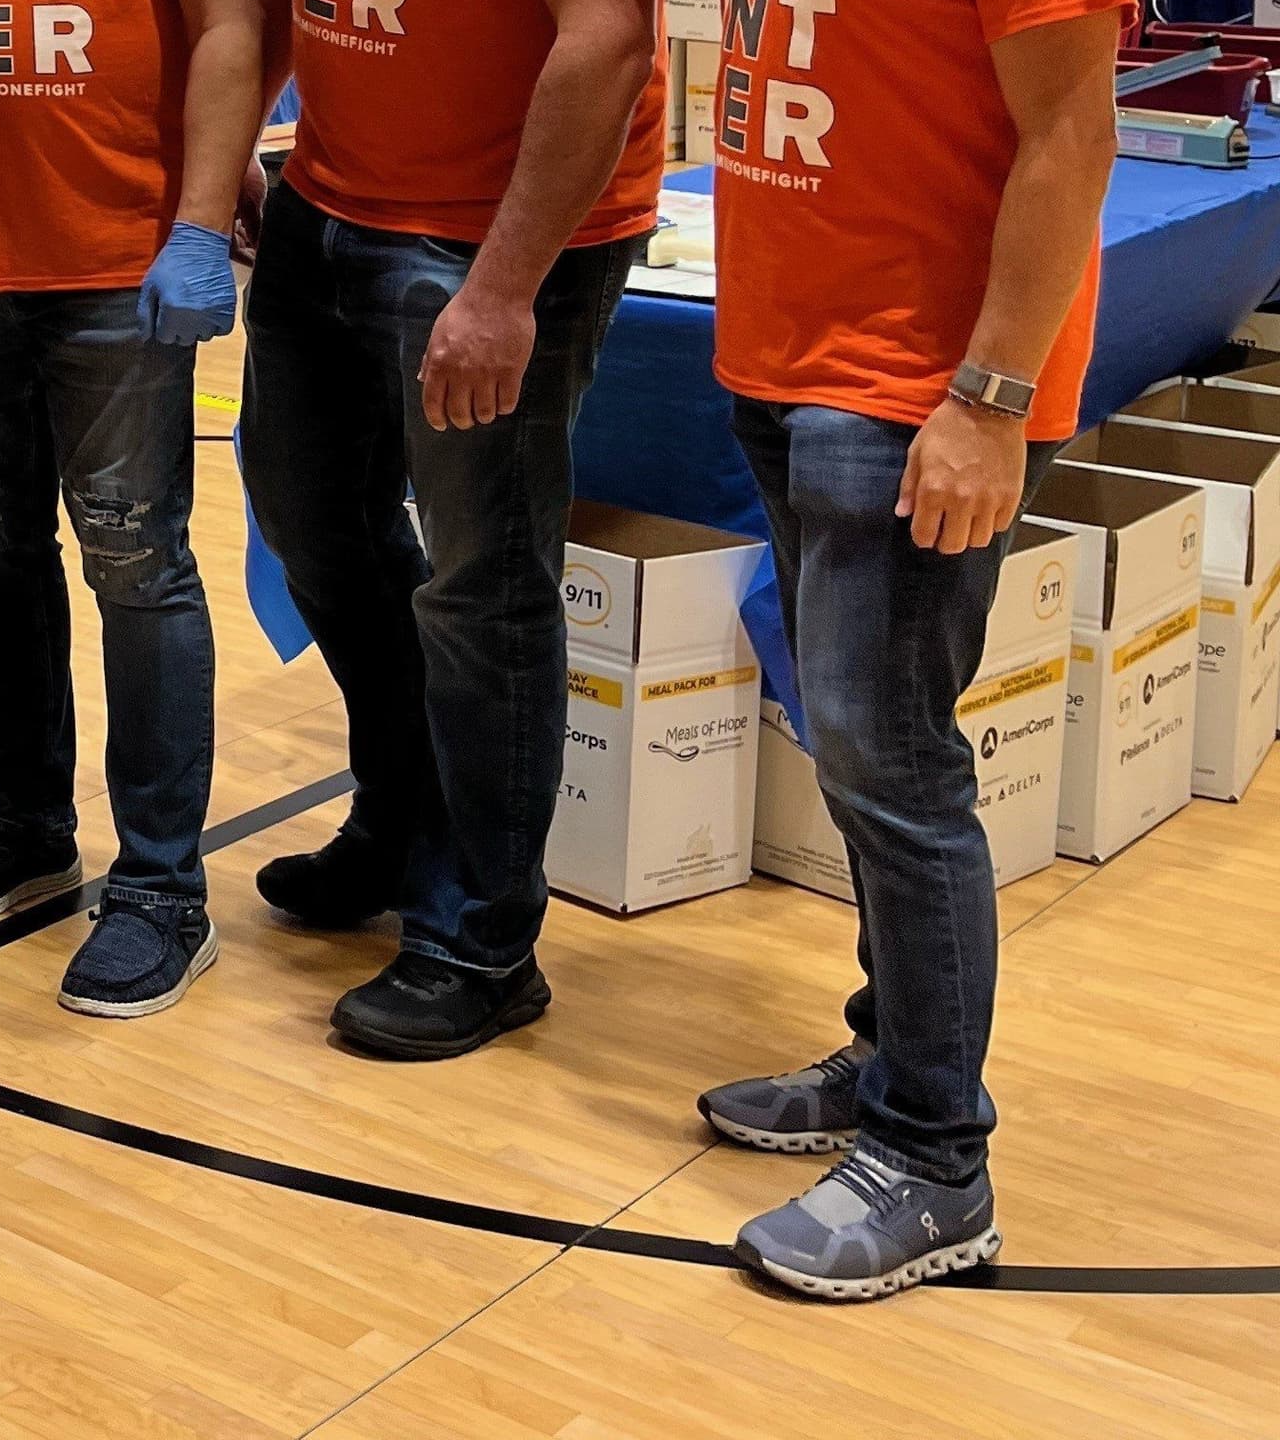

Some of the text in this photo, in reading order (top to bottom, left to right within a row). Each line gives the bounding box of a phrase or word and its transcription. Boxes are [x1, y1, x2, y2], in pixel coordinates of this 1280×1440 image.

[565, 584, 603, 610] 9/11
[1040, 581, 1061, 602] 9/11
[647, 683, 672, 697] MEAL
[674, 678, 697, 692] PACK
[699, 675, 716, 688] FOR
[665, 724, 699, 745] Meals
[701, 719, 716, 737] of
[717, 715, 748, 737] Hope
[1001, 714, 1054, 745] AmeriCorps
[1008, 772, 1041, 797] DELTA
